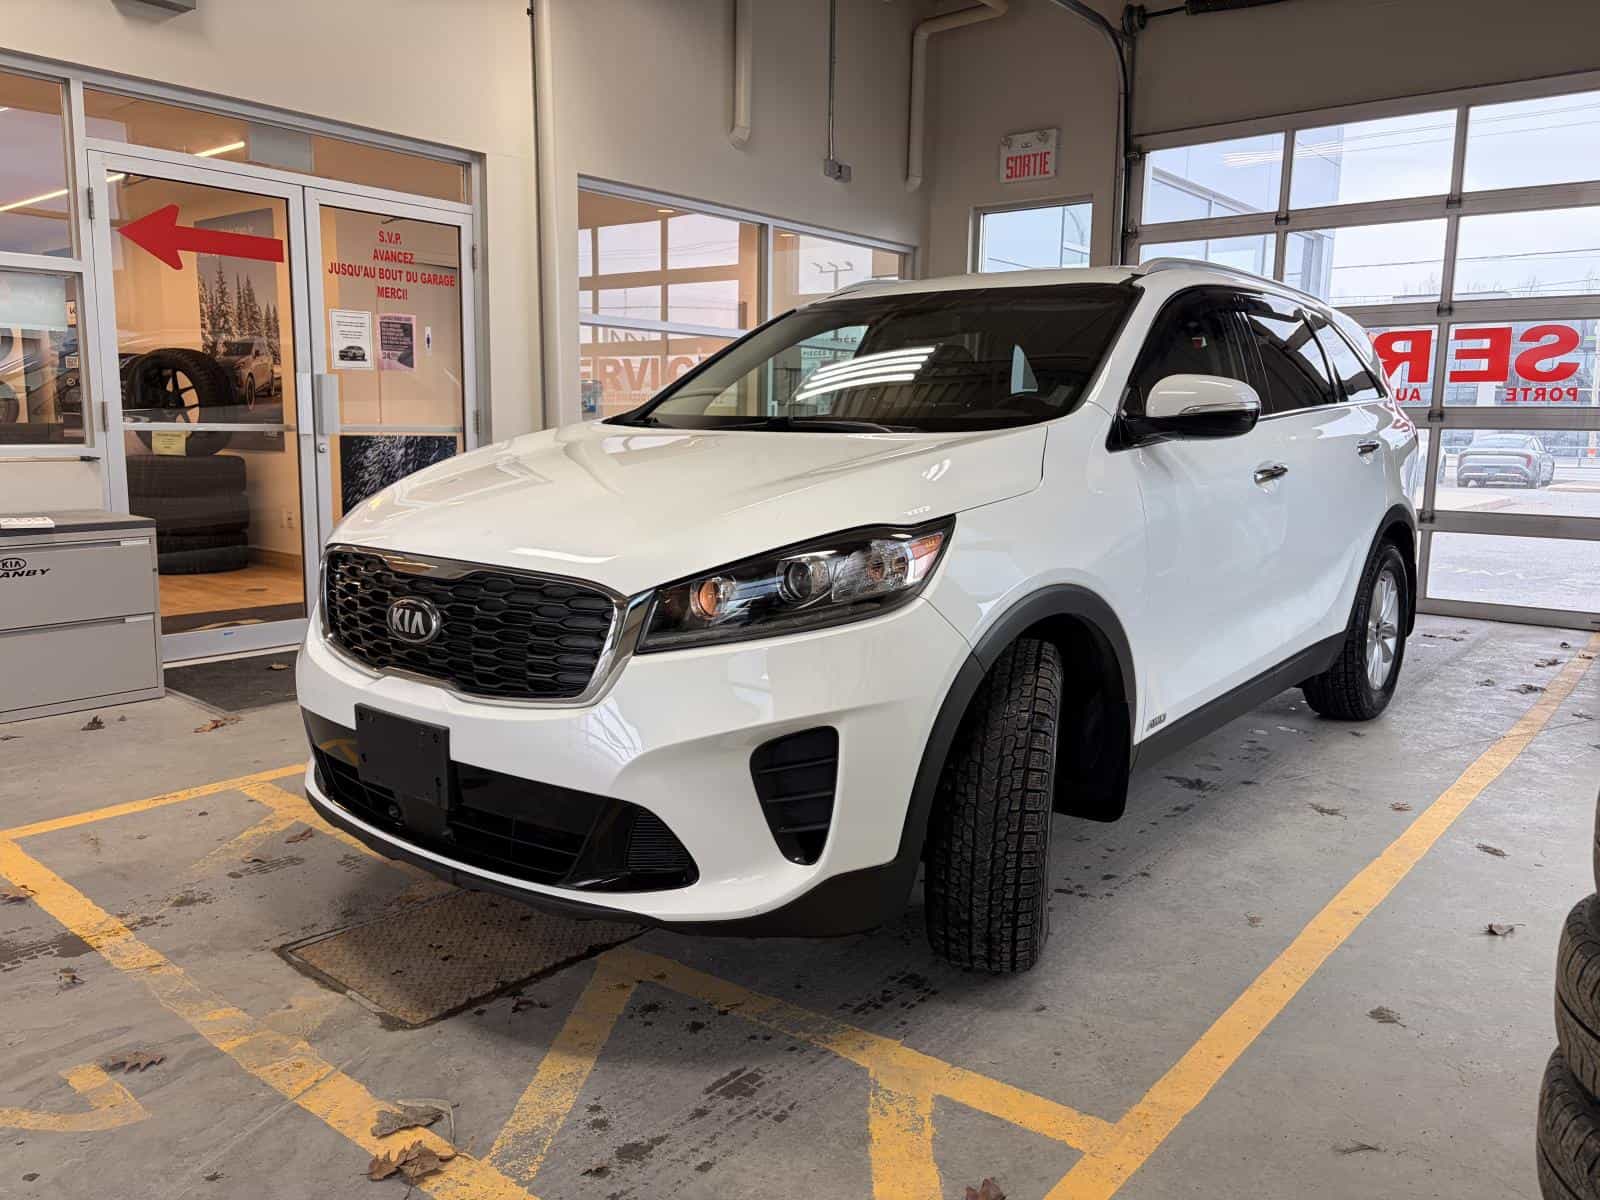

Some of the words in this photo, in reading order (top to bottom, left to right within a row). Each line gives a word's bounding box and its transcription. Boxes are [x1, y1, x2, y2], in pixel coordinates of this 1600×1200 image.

[1005, 151, 1051, 179] SORTIE
[378, 230, 402, 245] S.V.P.
[373, 248, 415, 265] AVANCEZ
[328, 262, 376, 279] JUSQU'AU
[378, 267, 403, 282] BOUT
[406, 271, 418, 283] DU
[420, 273, 455, 287] GARAGE
[1, 560, 22, 569] KIA
[392, 607, 426, 636] KIA
